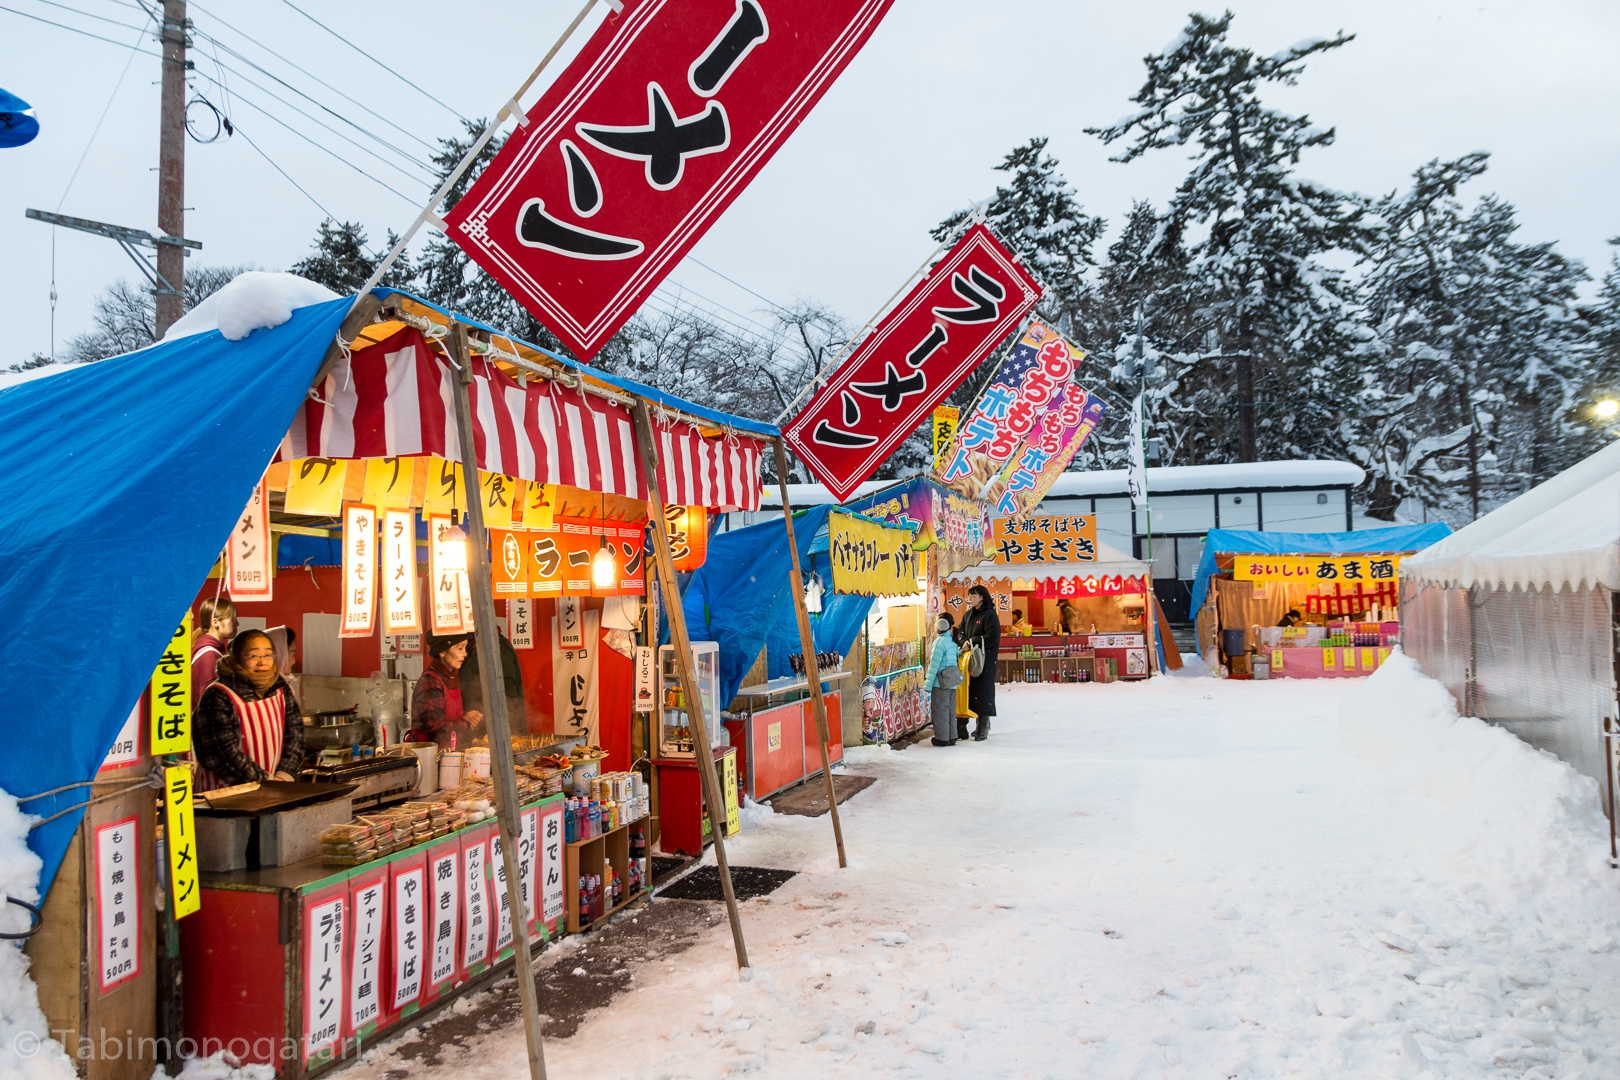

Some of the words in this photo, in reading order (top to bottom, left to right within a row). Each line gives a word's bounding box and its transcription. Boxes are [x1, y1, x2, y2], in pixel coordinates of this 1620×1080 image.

[514, 0, 769, 261] ーメン
[812, 265, 1006, 449] ラーメン
[986, 337, 1072, 462] もちもち
[940, 382, 1025, 484] ポテト
[996, 380, 1088, 517] もちもちポテト
[664, 503, 690, 560] ラーメン
[1002, 518, 1087, 535] 支那そばや
[354, 515, 368, 605] やきそば
[393, 521, 407, 603] ラーメン
[533, 536, 642, 578] ラーン
[997, 536, 1096, 563] やまざき
[1250, 563, 1309, 577] おいしい
[1316, 559, 1394, 579] あま酒
[236, 570, 261, 582] 600円
[1060, 575, 1120, 596] おでん
[349, 612, 368, 622] 500円
[391, 611, 411, 621] 600円
[565, 649, 588, 661] 辛口
[641, 650, 650, 684] おしるこ
[107, 740, 133, 755] 00円
[171, 778, 195, 903] ラーメン
[546, 819, 559, 886] おでん
[111, 831, 126, 927] もも焼き鳥
[437, 859, 452, 942] 焼き鳥
[334, 902, 342, 953] お持ち帰り
[403, 878, 417, 979] やきそば
[106, 959, 132, 979] 500円
[319, 913, 334, 1019] ラーメン
[434, 963, 451, 980] 500円
[468, 950, 483, 964] 500円
[397, 982, 418, 1000] 500円
[355, 1002, 377, 1023] 700円
